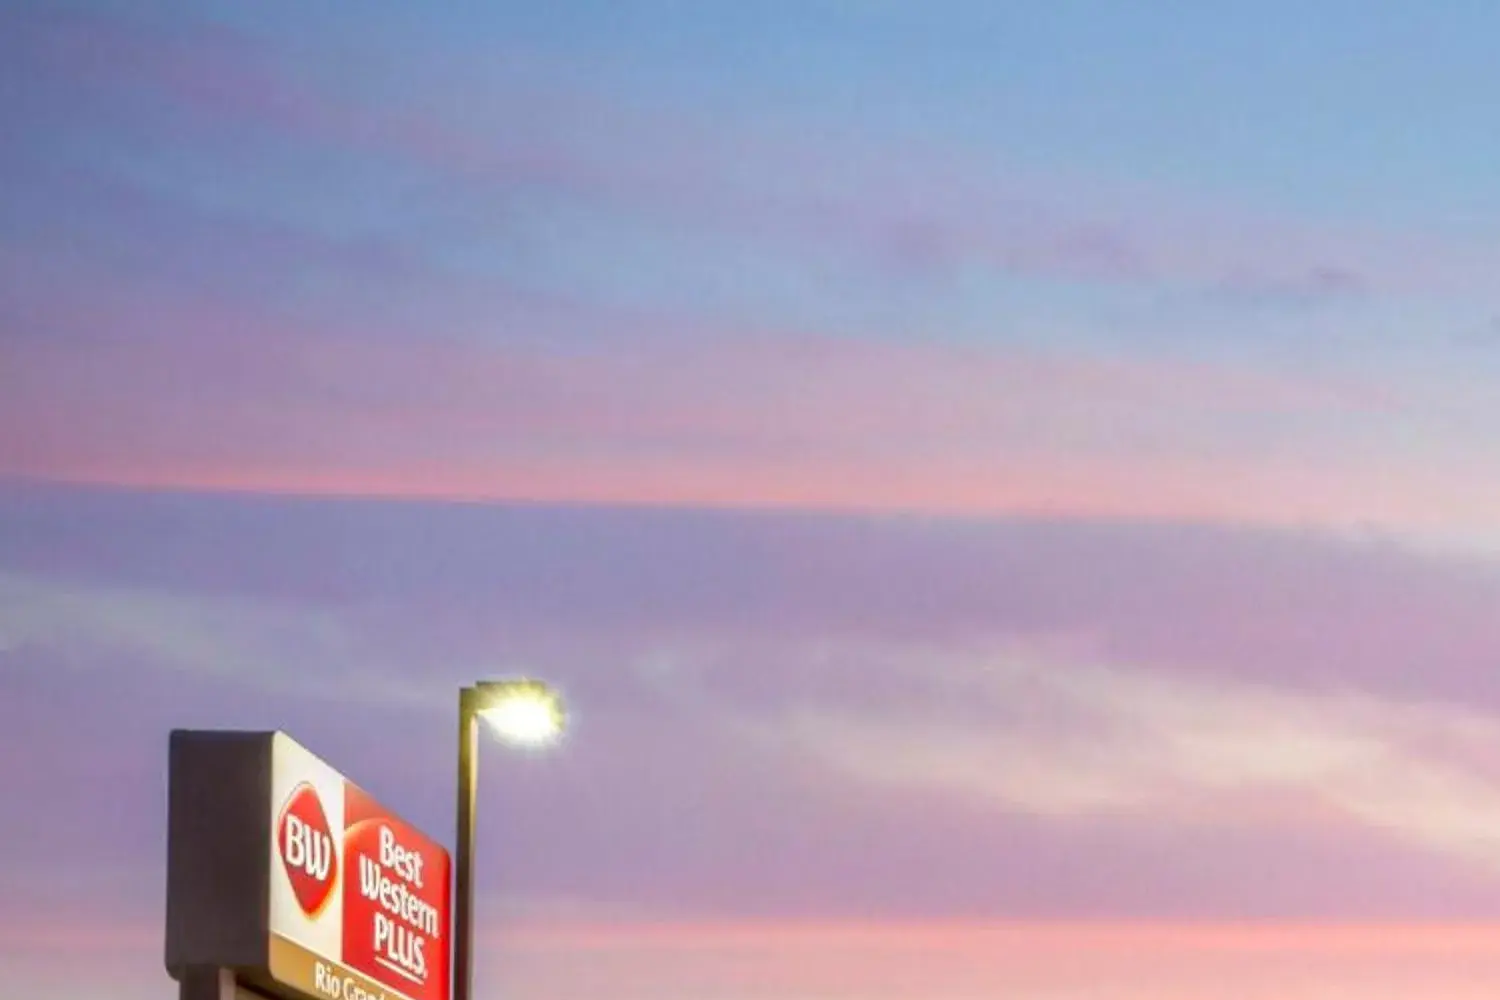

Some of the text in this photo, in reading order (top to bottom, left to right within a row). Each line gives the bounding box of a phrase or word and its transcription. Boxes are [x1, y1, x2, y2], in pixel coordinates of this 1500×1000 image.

[285, 814, 331, 881] BW
[380, 825, 423, 887] Best
[359, 854, 438, 937] Western
[373, 911, 426, 974] PLUS
[314, 961, 340, 999] Rio
